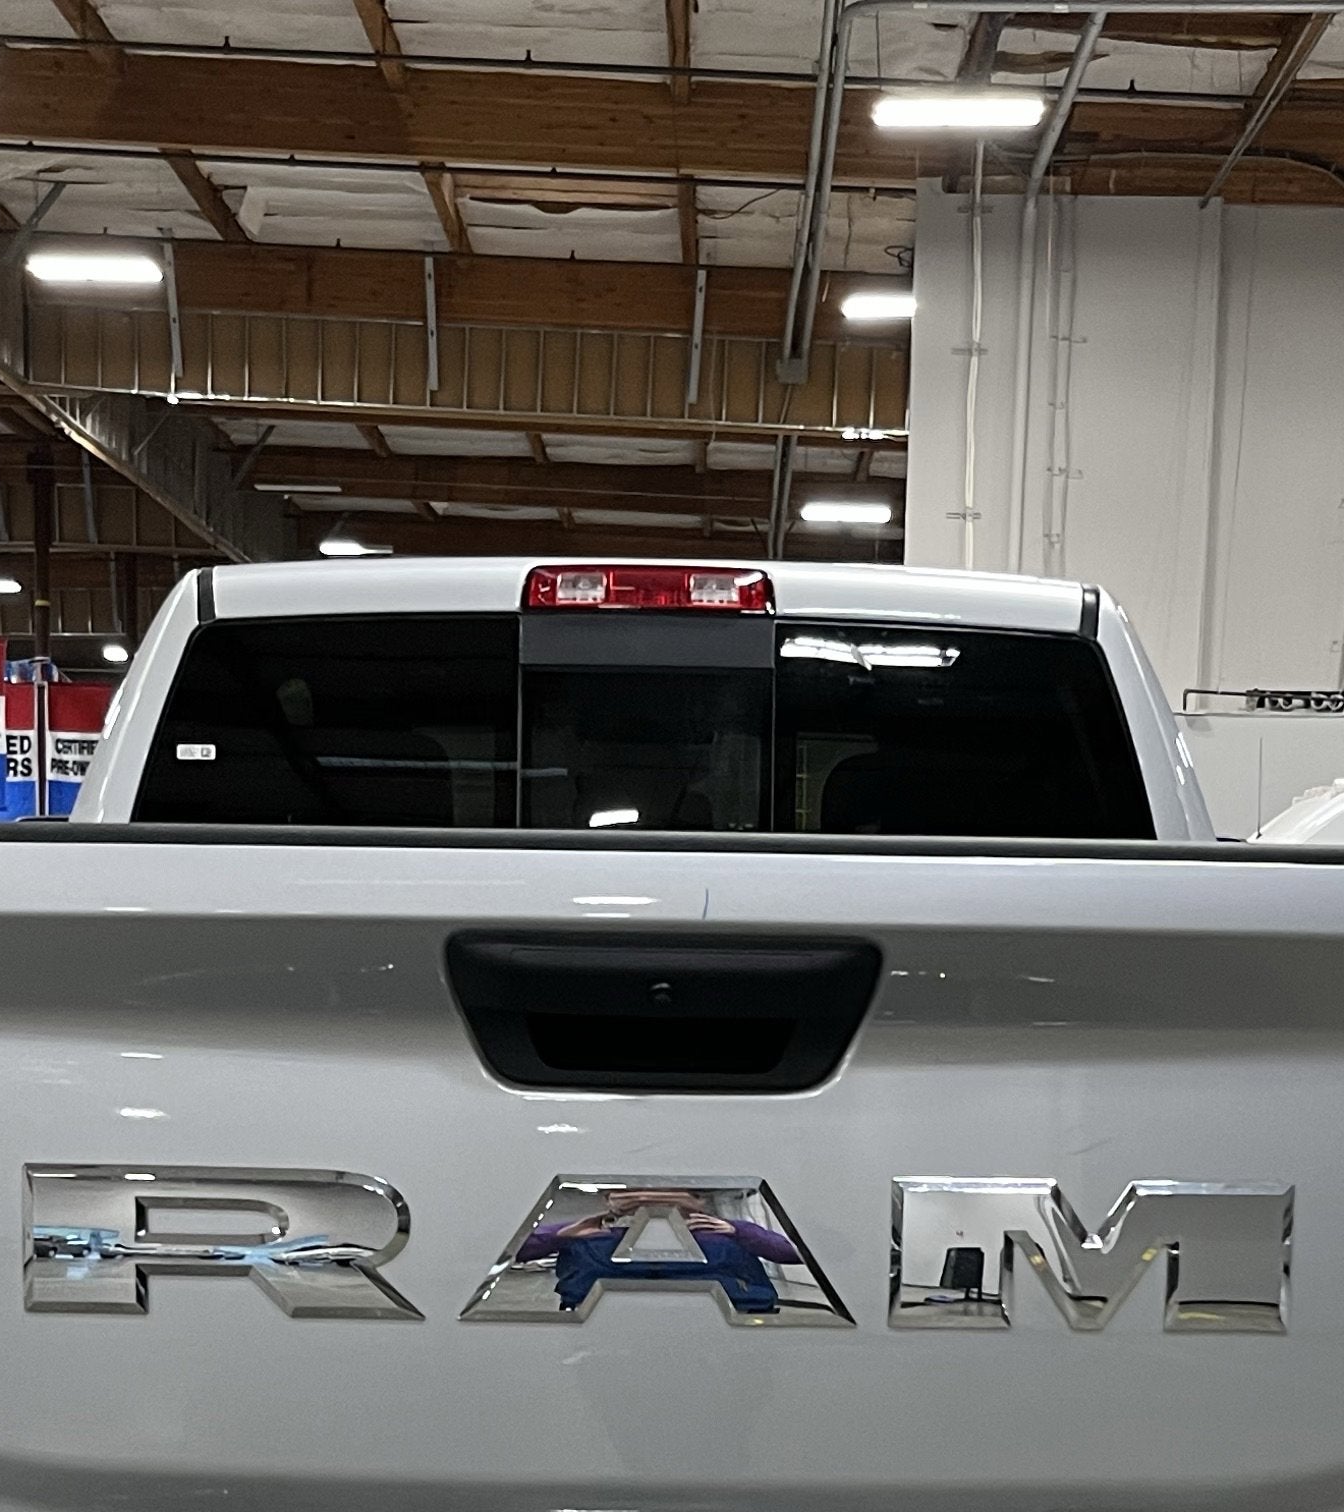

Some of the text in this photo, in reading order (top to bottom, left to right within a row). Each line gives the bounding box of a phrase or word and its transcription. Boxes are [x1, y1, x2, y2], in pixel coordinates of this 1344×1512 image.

[6, 735, 32, 755] ED
[6, 758, 32, 777] RS
[22, 1162, 1296, 1334] RAM
